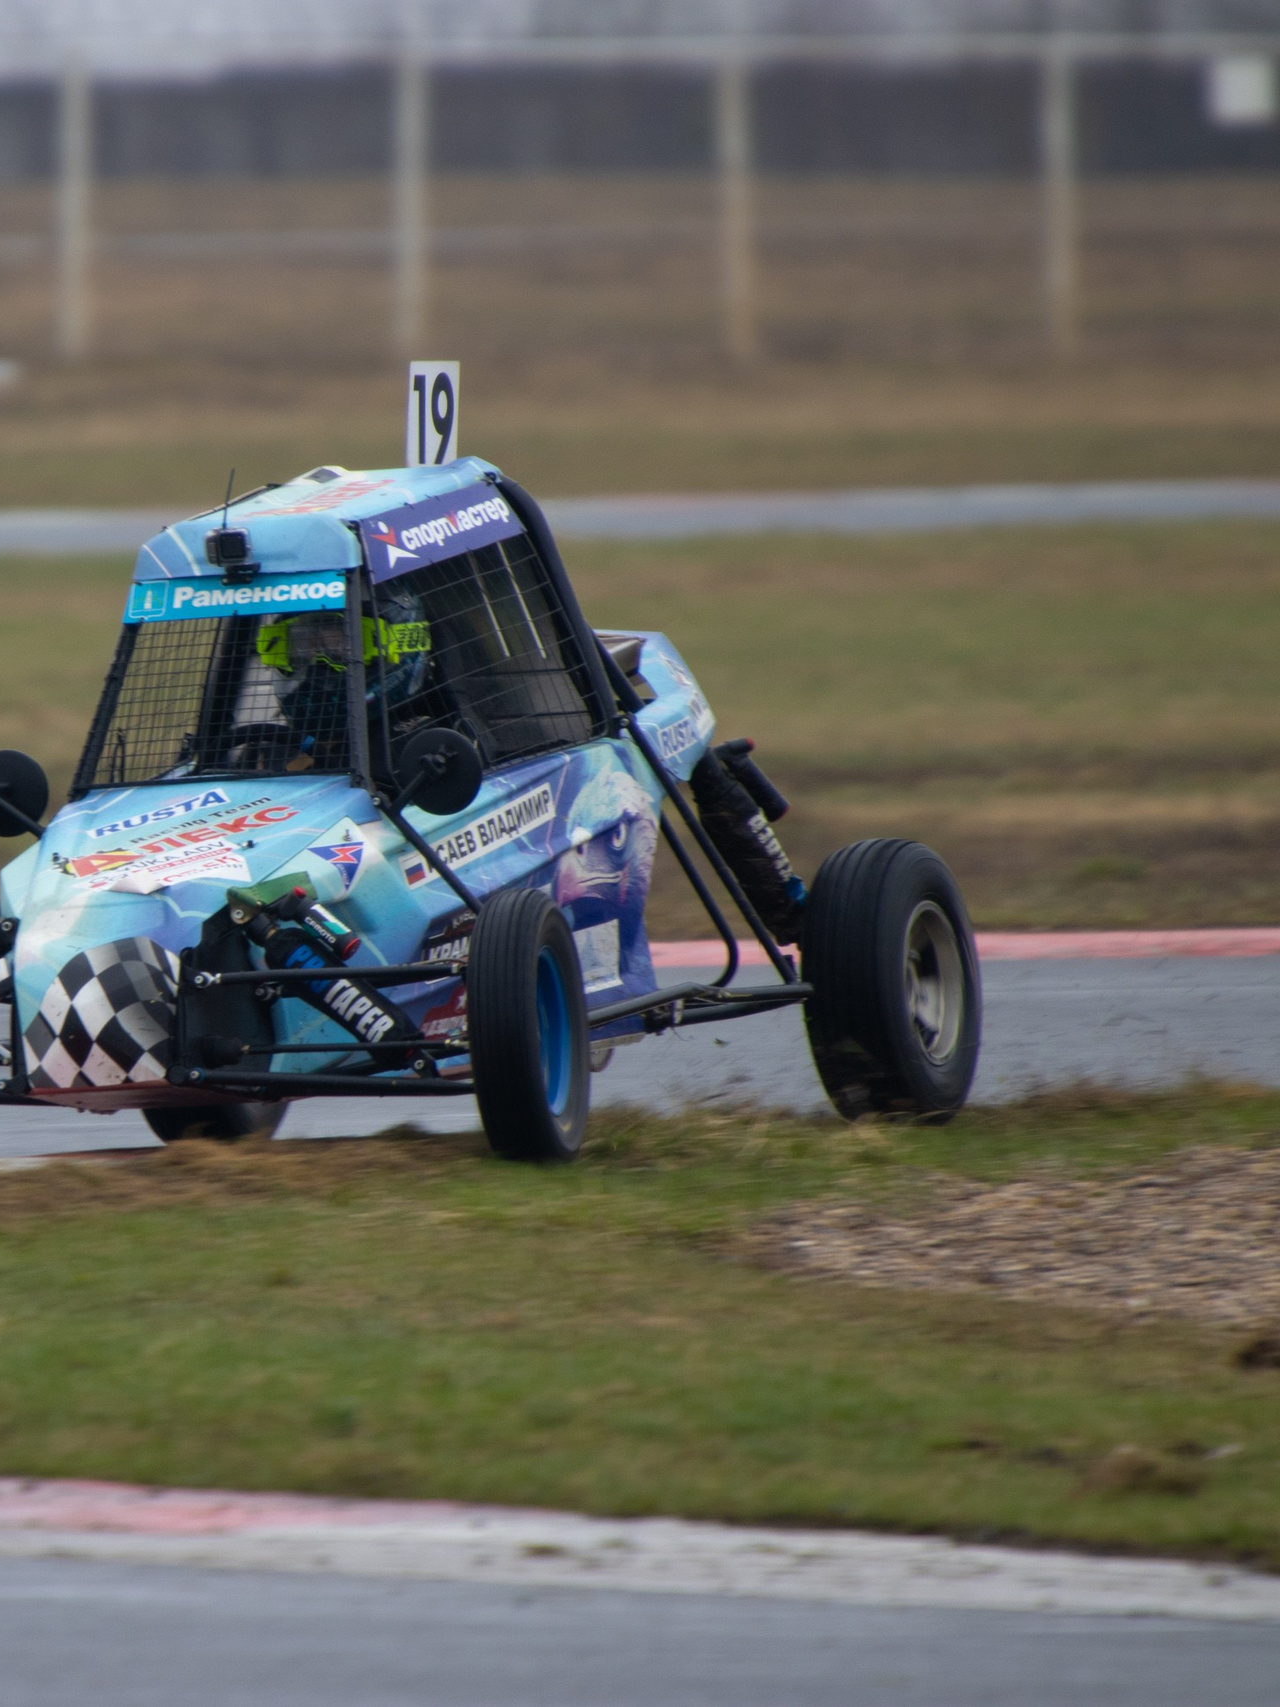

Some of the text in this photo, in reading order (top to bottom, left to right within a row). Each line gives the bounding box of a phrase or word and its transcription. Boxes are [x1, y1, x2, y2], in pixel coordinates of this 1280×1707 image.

[413, 372, 455, 465] 19
[172, 580, 346, 609] Раменское
[70, 805, 301, 878] АЛЕКС
[95, 790, 228, 838] RUSTA
[129, 796, 273, 844] Racing Team
[428, 788, 551, 874] САЕВ ВЛАДИМИР
